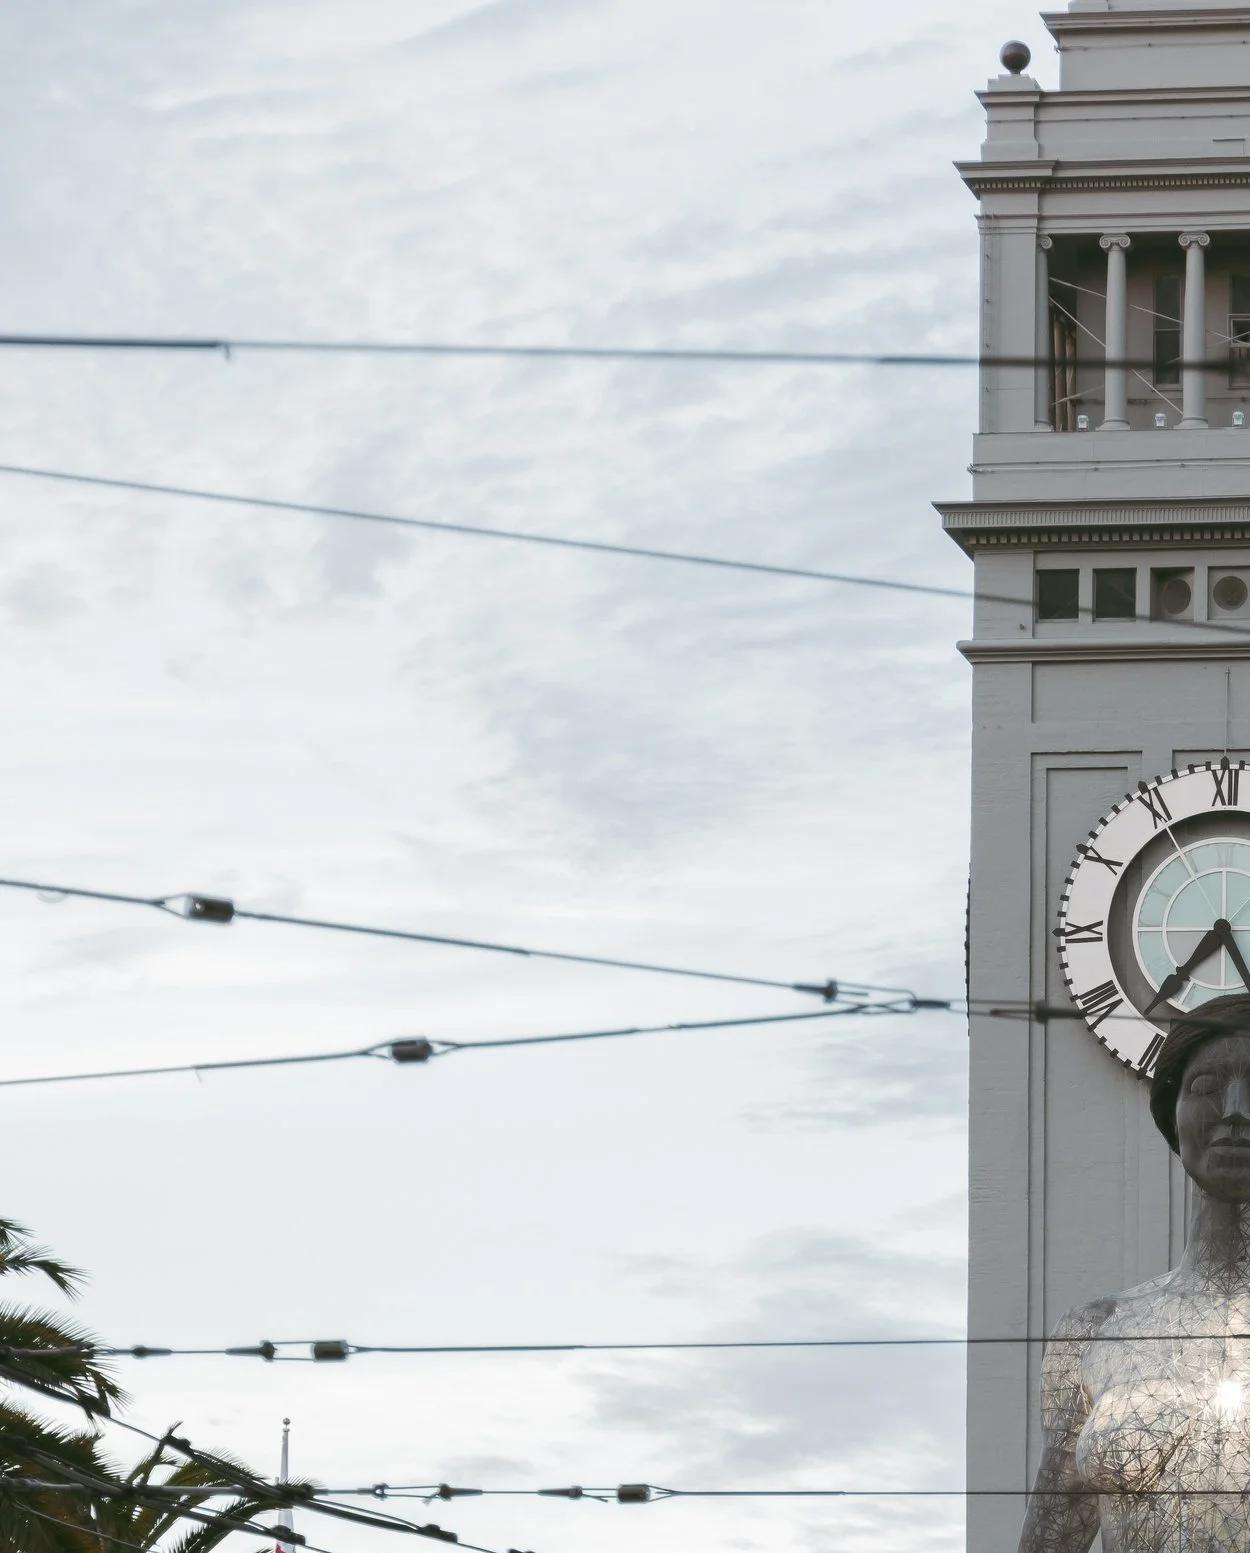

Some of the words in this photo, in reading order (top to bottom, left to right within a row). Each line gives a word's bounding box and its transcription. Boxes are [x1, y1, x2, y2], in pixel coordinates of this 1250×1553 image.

[1211, 769, 1239, 807] XII
[1137, 787, 1172, 829] XI
[1083, 846, 1123, 876] X
[1065, 920, 1103, 944] IX
